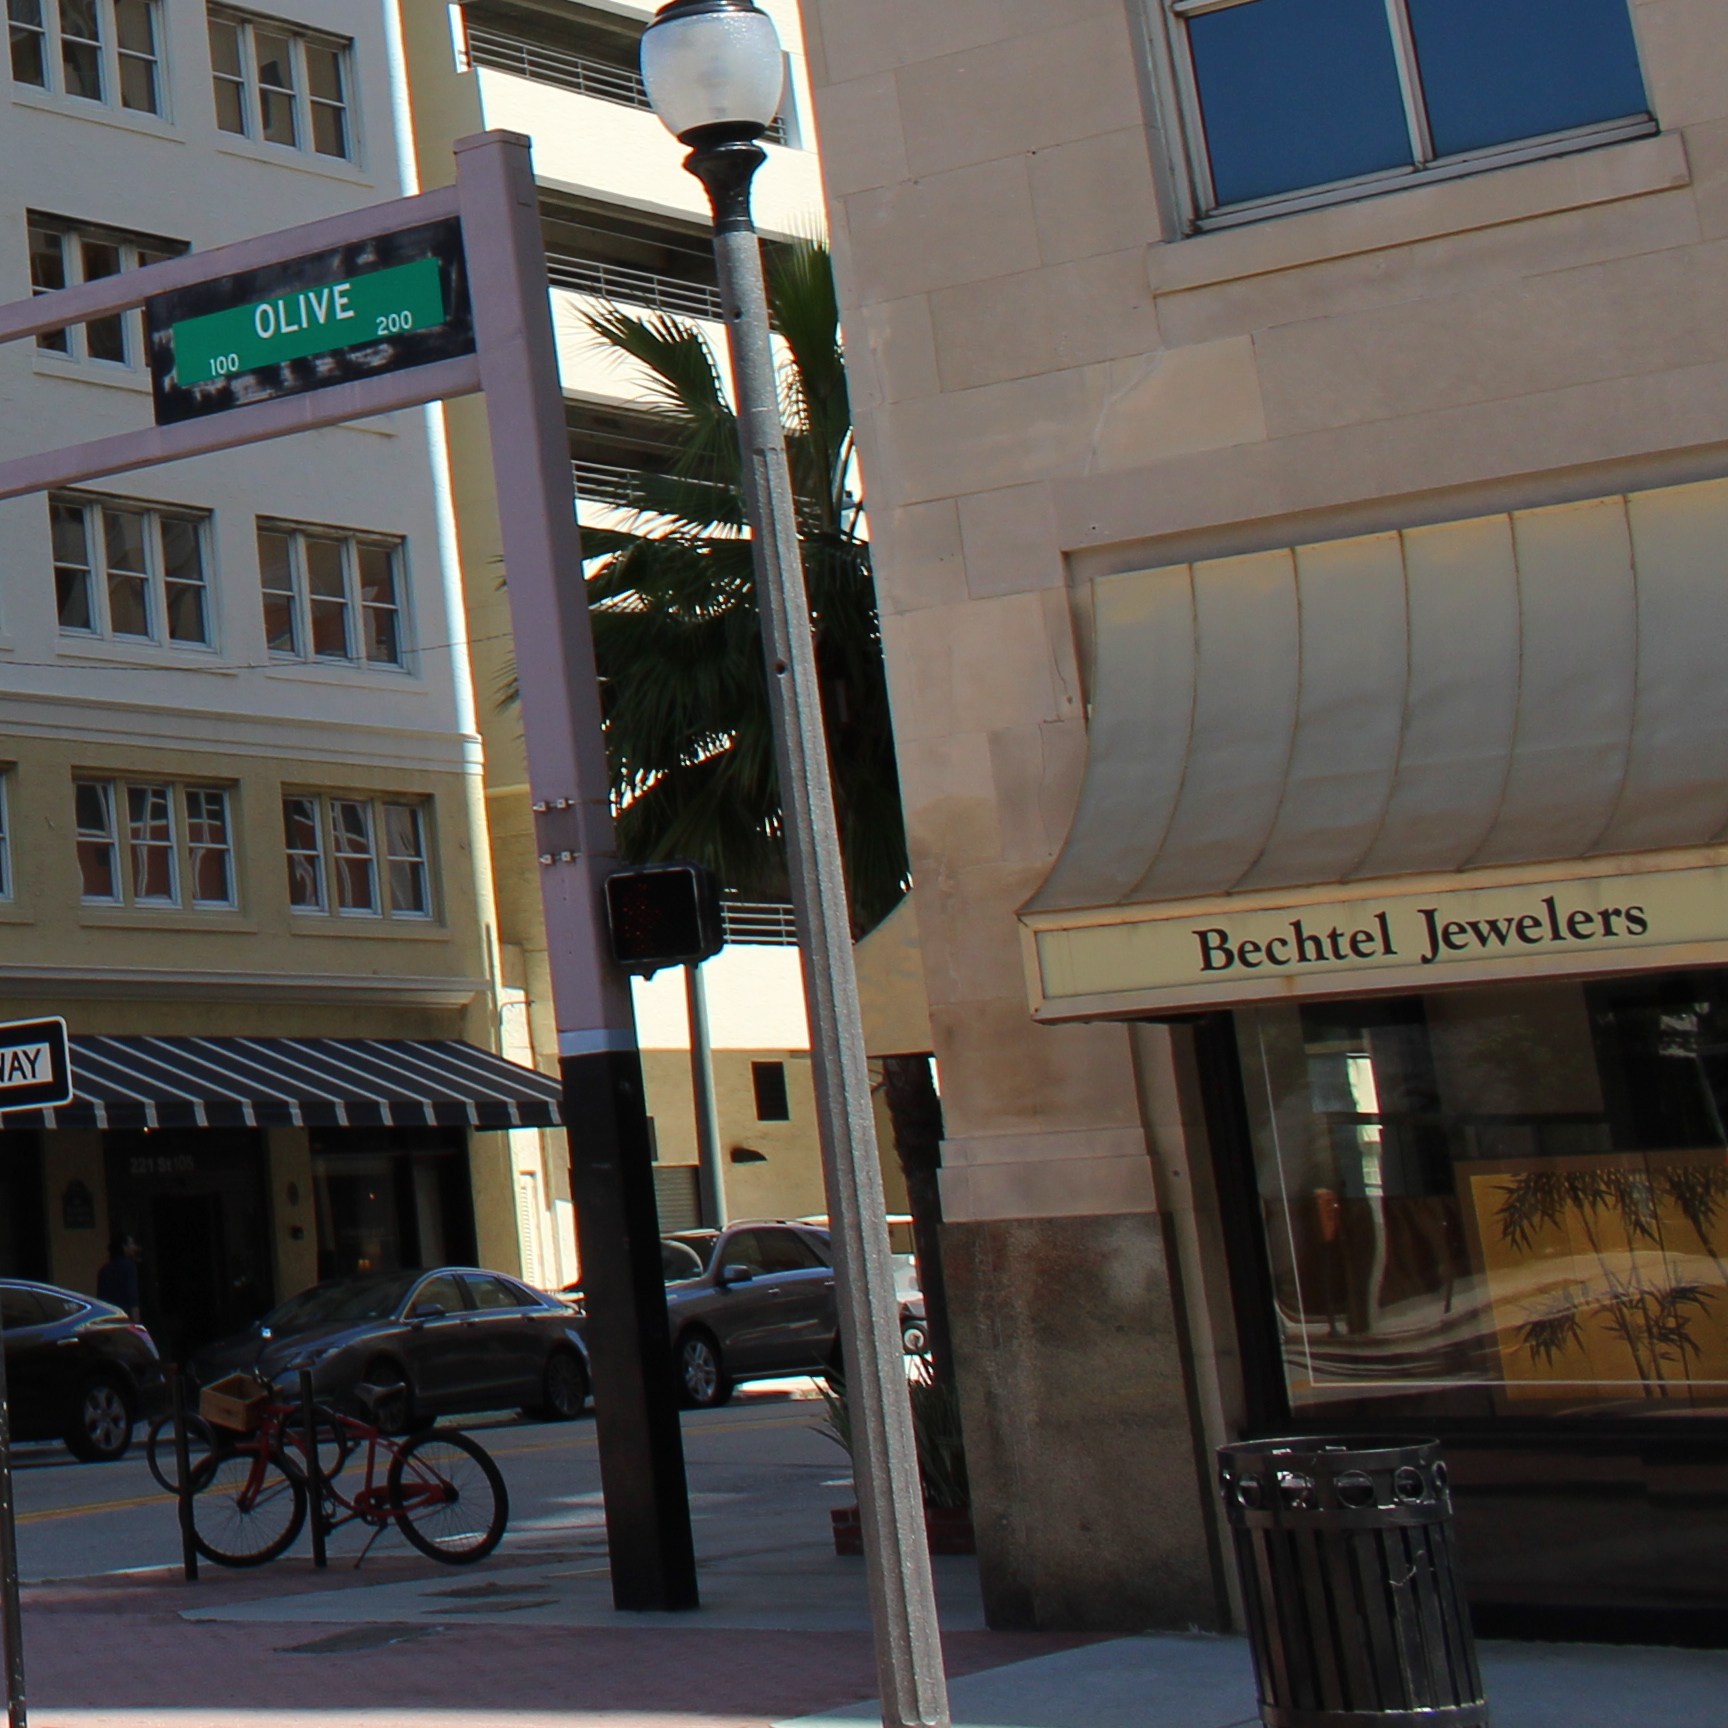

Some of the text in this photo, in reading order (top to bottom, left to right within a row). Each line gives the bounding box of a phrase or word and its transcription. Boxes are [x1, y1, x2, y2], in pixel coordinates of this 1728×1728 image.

[209, 309, 413, 377] 100 200
[254, 282, 356, 339] OLIVE
[1192, 896, 1649, 972] Bechtel Jewelers
